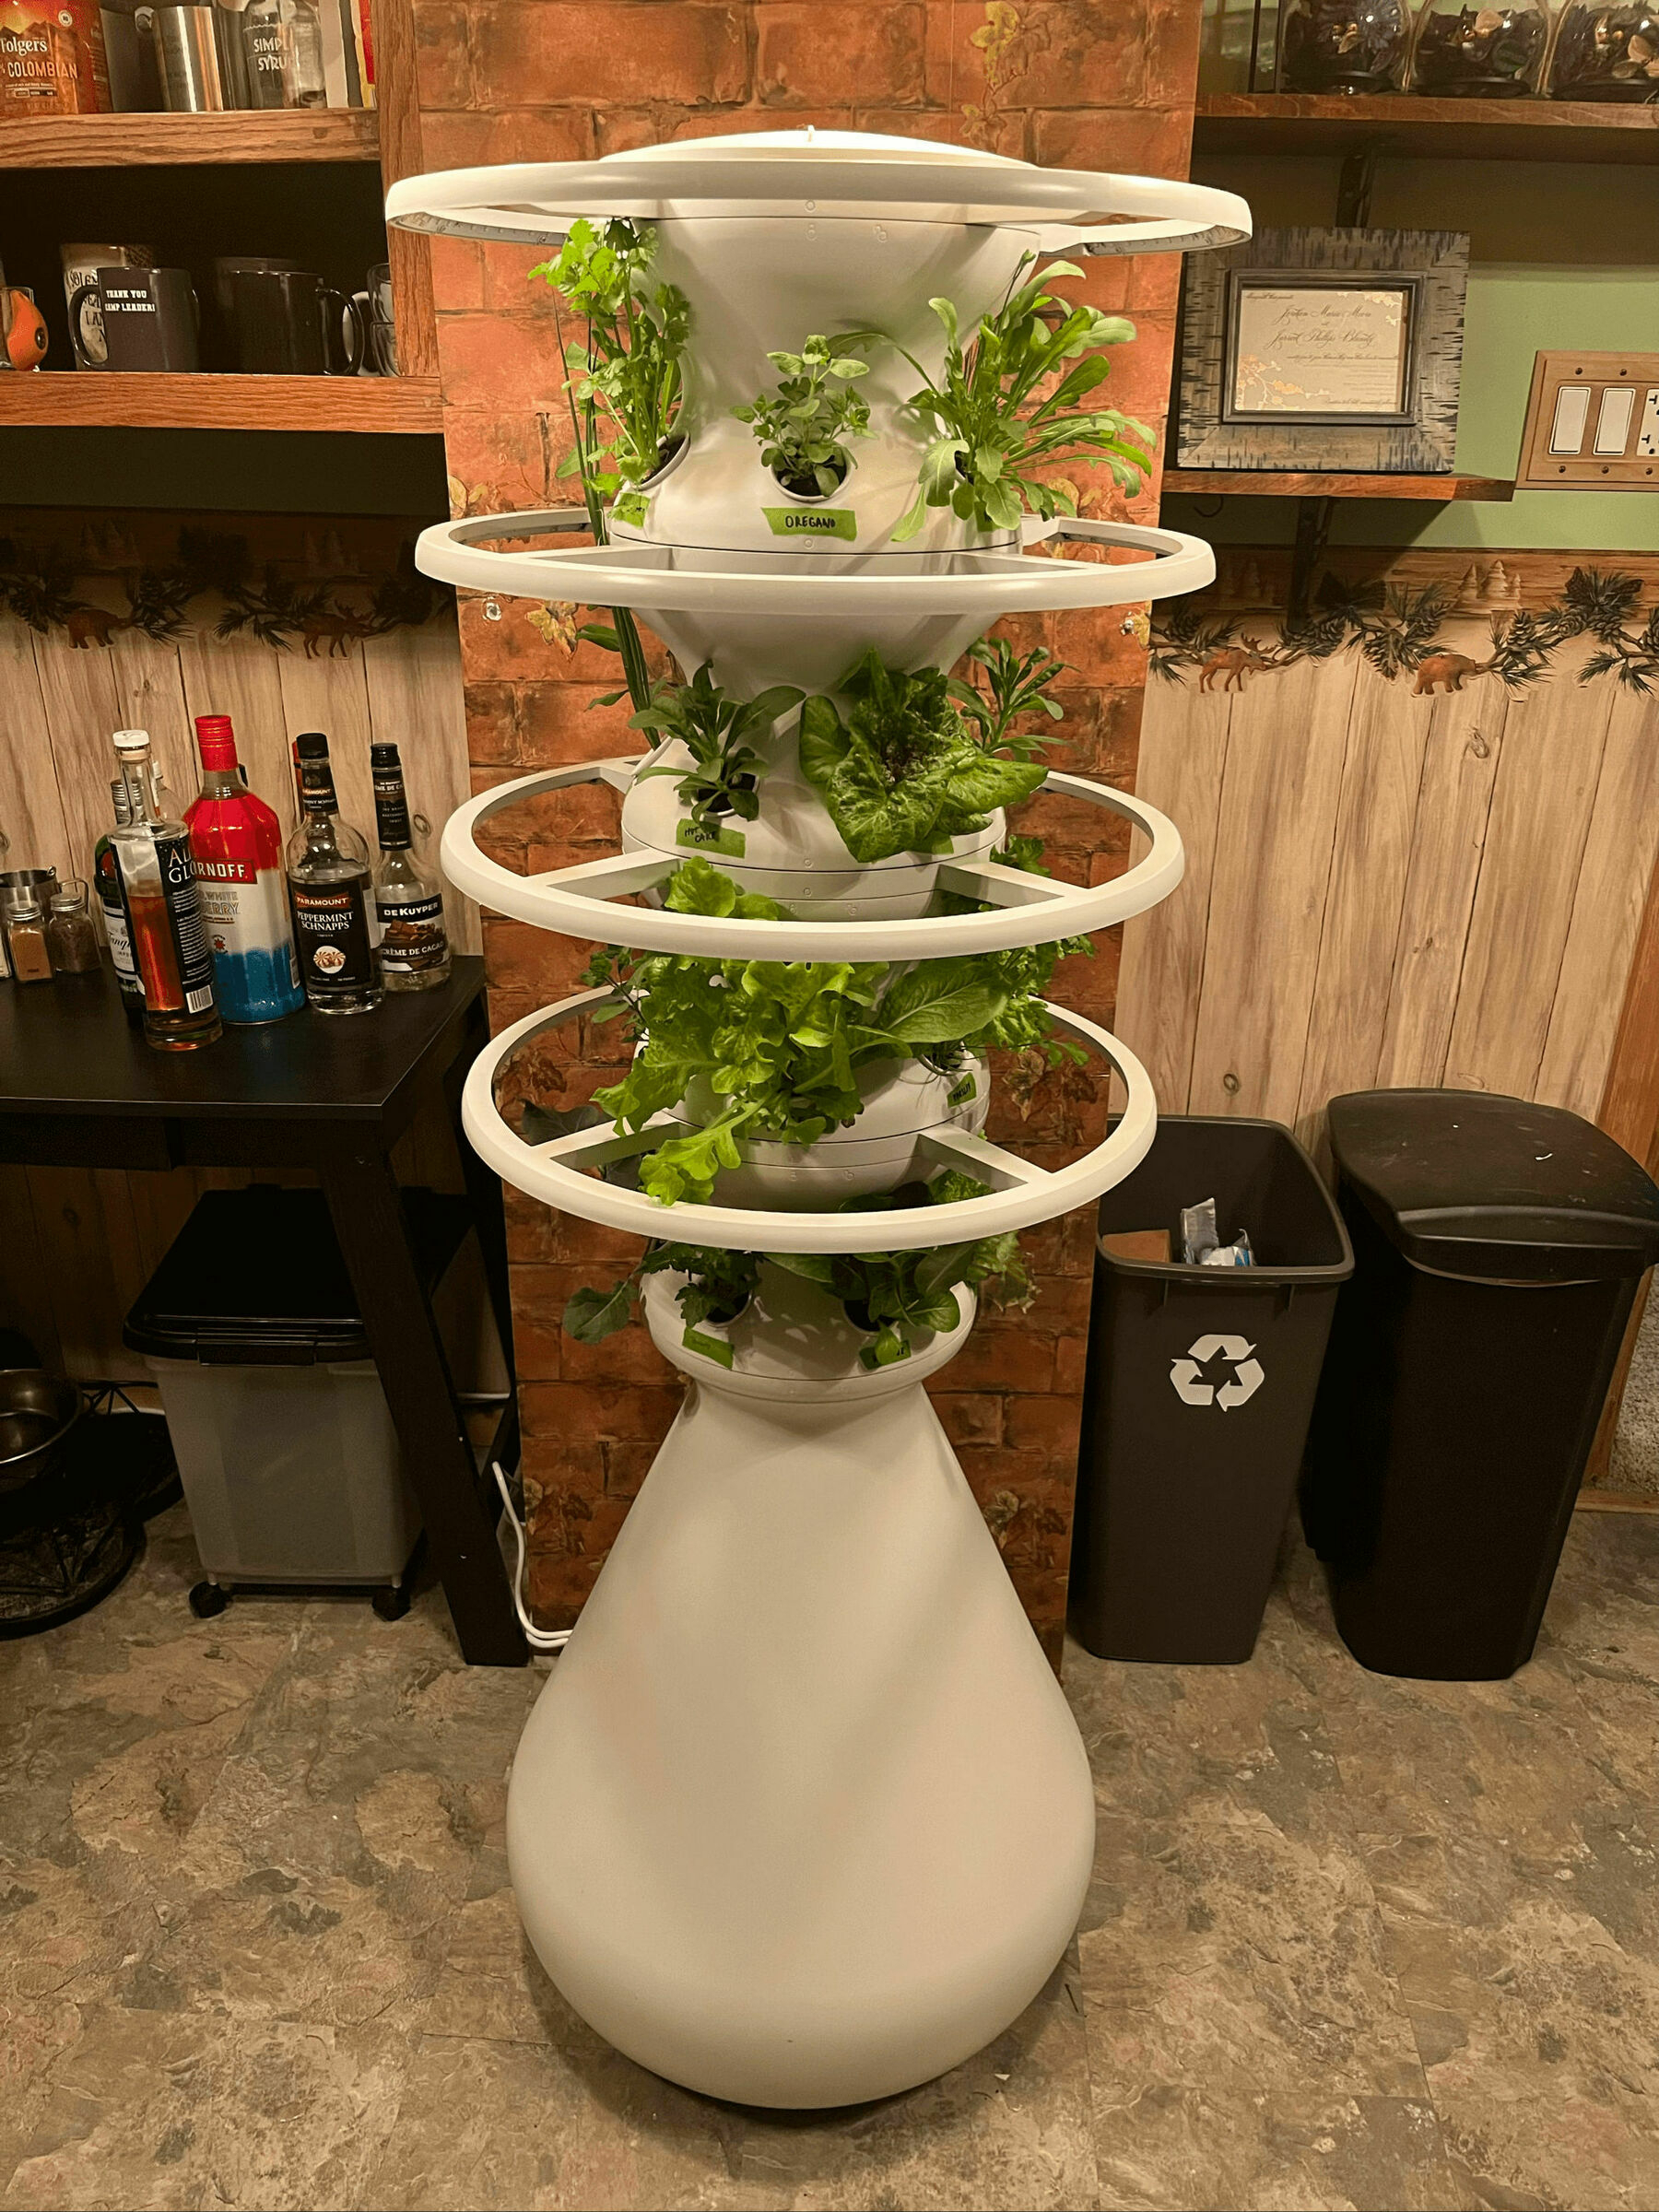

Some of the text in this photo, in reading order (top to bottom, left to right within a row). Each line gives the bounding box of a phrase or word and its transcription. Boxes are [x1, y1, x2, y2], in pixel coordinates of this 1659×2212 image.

[7, 61, 77, 79] COLOMBIAN
[106, 289, 147, 299] THANK YOU
[296, 897, 349, 906] PARAMOUNT
[297, 911, 354, 923] PEPPERMINT
[301, 921, 349, 932] SCHNAPPS
[408, 947, 420, 956] DE
